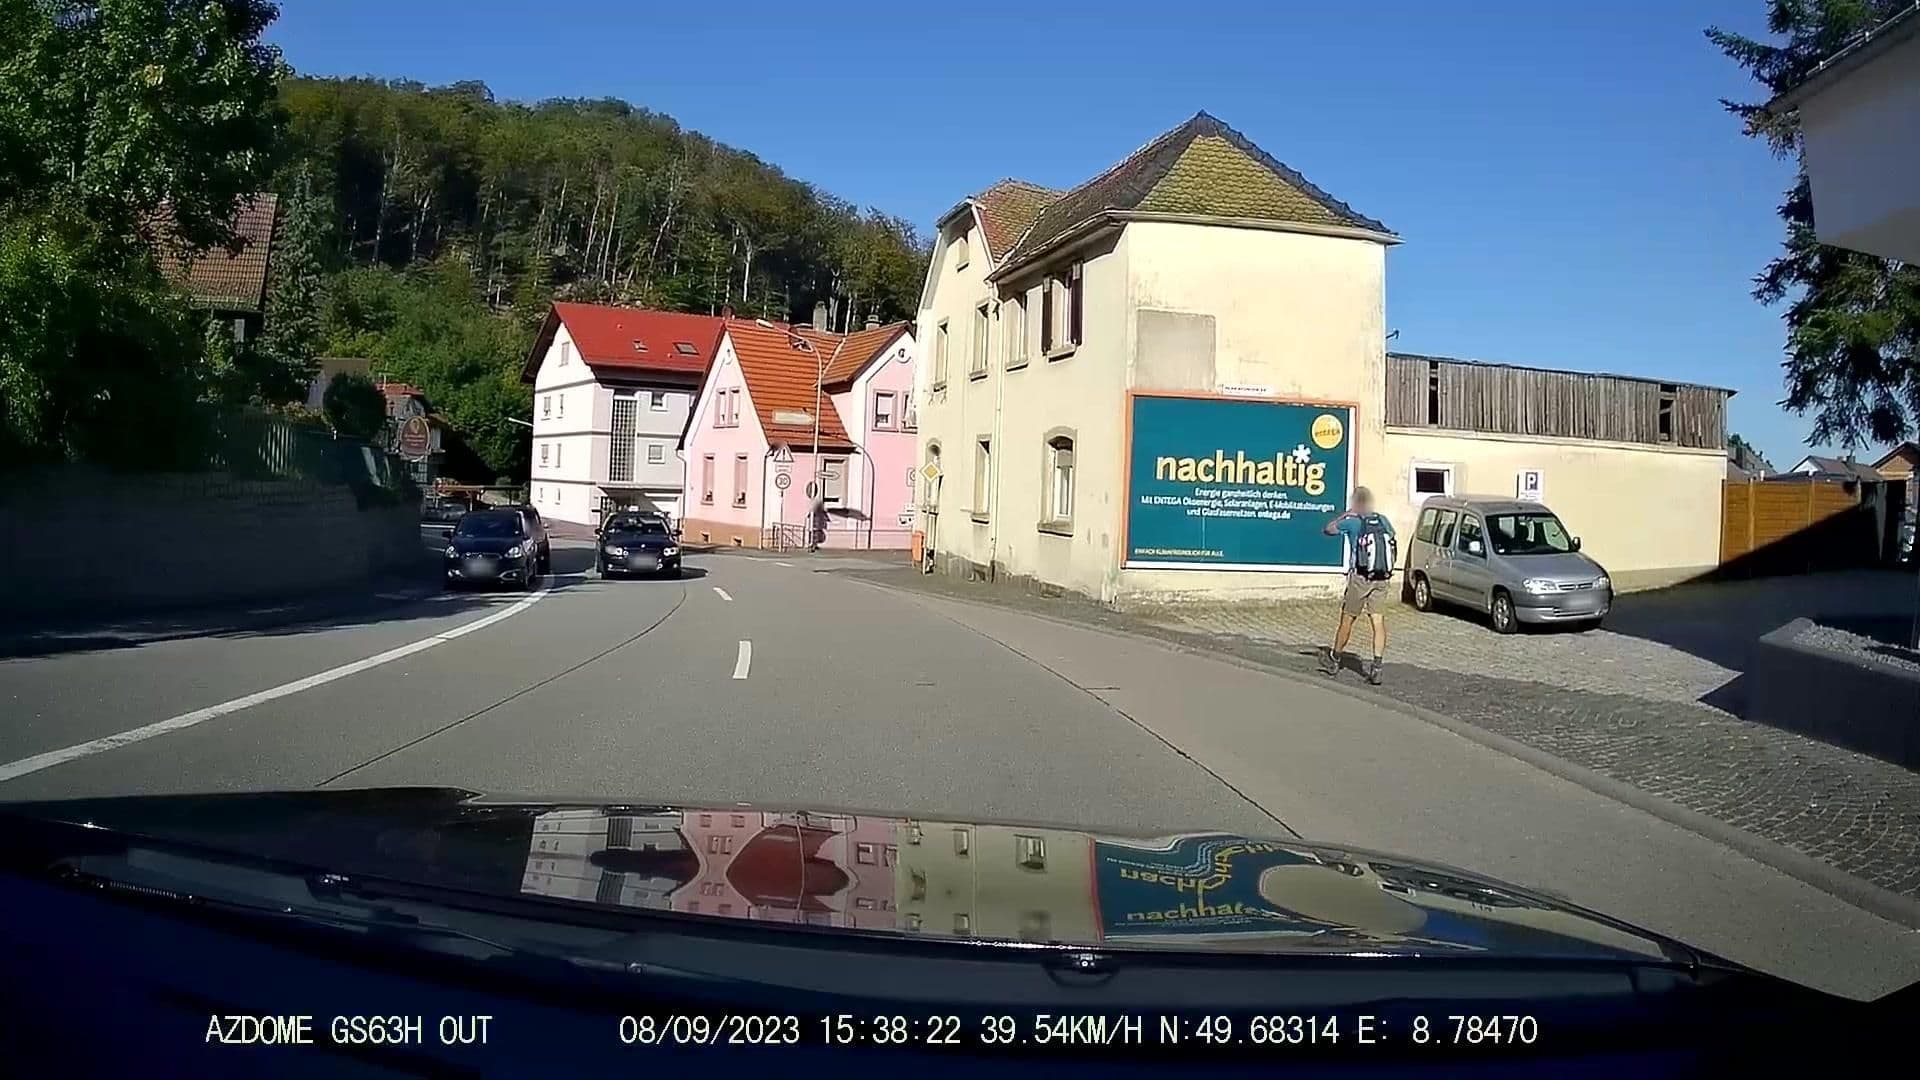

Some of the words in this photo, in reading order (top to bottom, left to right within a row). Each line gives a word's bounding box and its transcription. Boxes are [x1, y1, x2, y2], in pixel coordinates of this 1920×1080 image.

[1156, 449, 1327, 496] nachhaltig
[1195, 487, 1221, 498] Energie
[1141, 495, 1153, 504] Mit
[1154, 496, 1182, 505] ENTEGA
